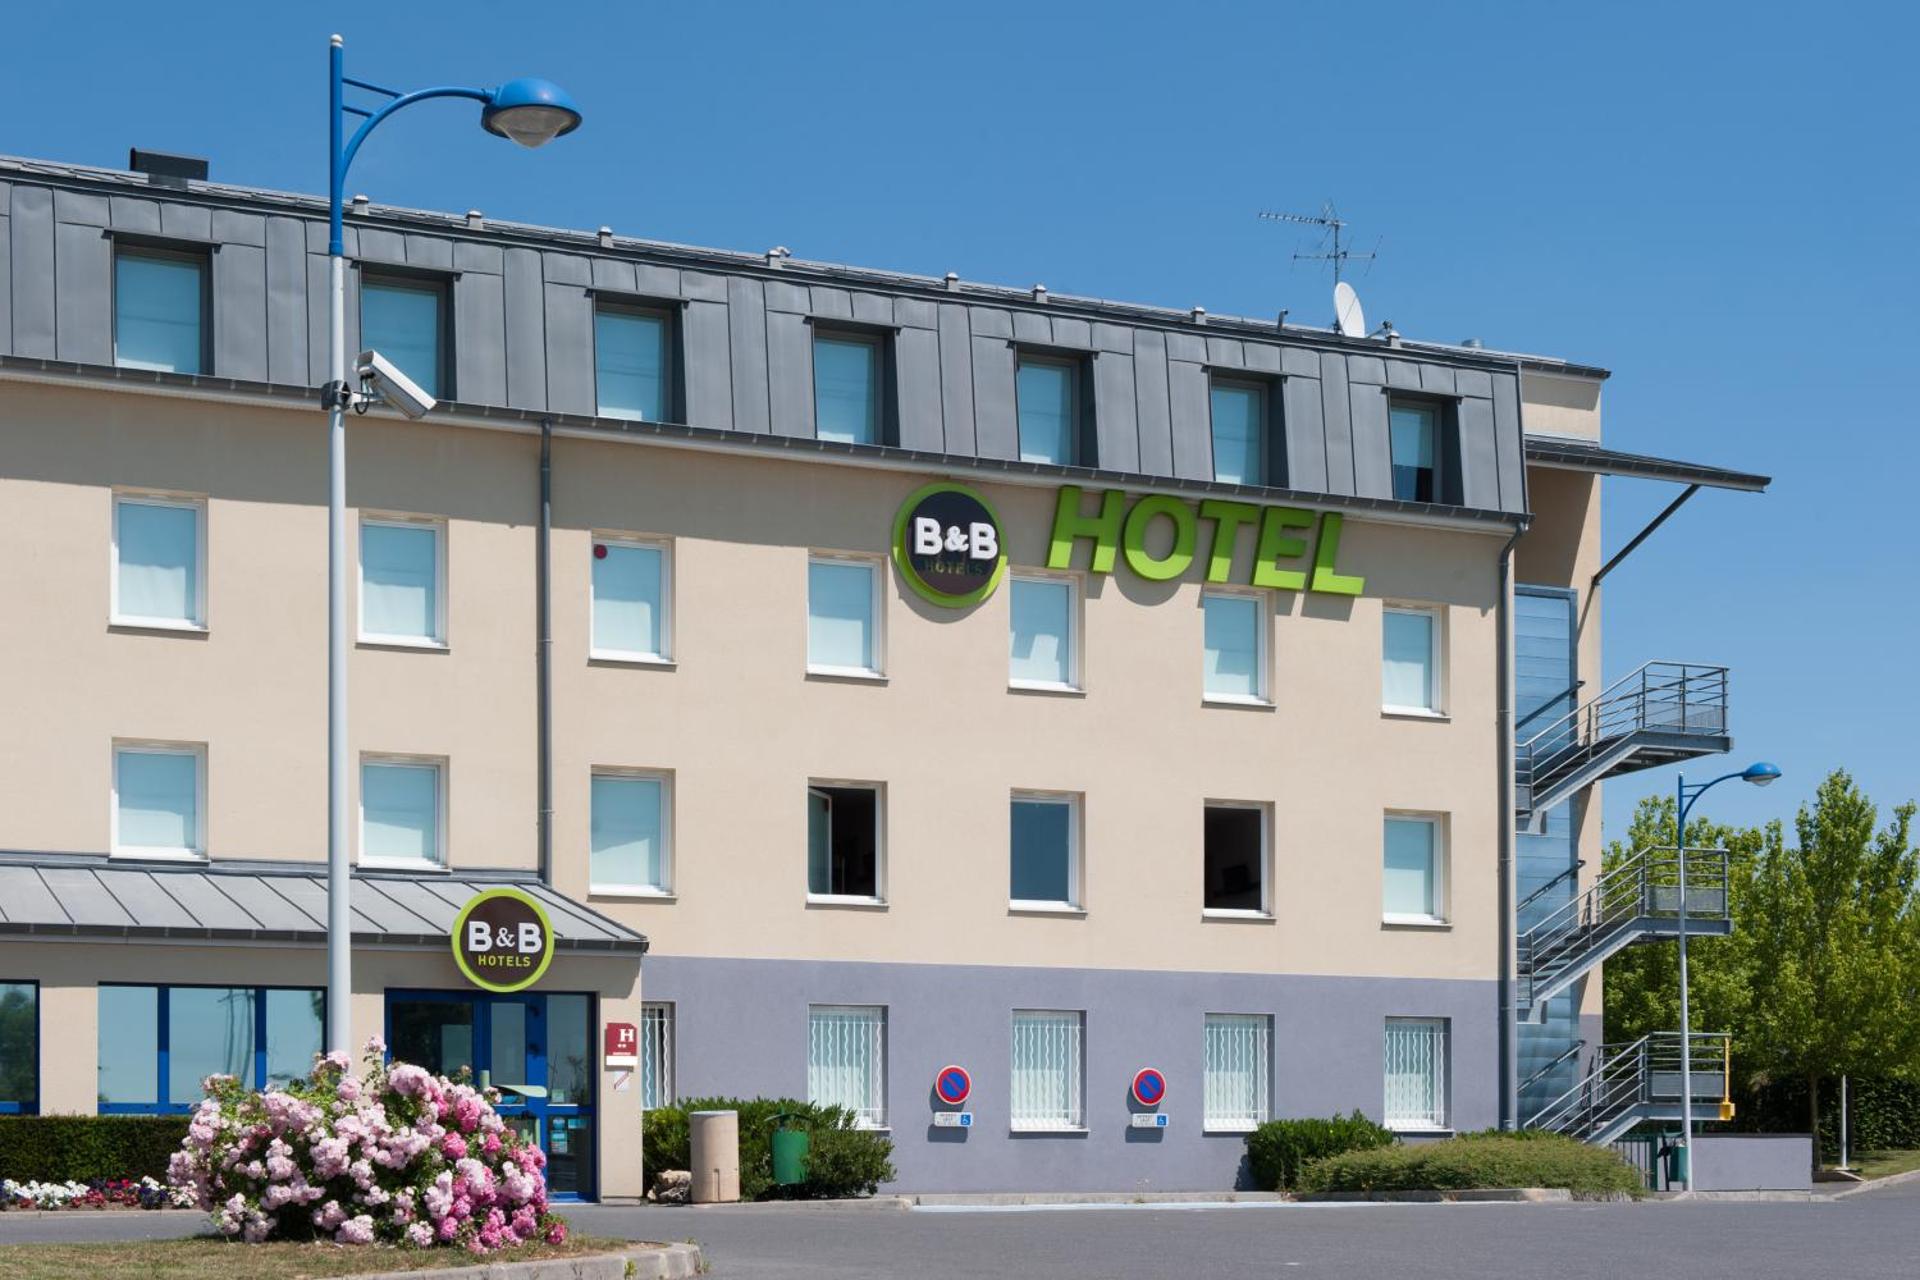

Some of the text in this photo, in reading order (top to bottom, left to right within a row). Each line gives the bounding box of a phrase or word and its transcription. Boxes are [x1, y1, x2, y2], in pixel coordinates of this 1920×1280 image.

[915, 517, 998, 560] B&B
[1047, 485, 1365, 595] HOTEL
[478, 955, 532, 967] HOTELS
[620, 1028, 634, 1042] H
